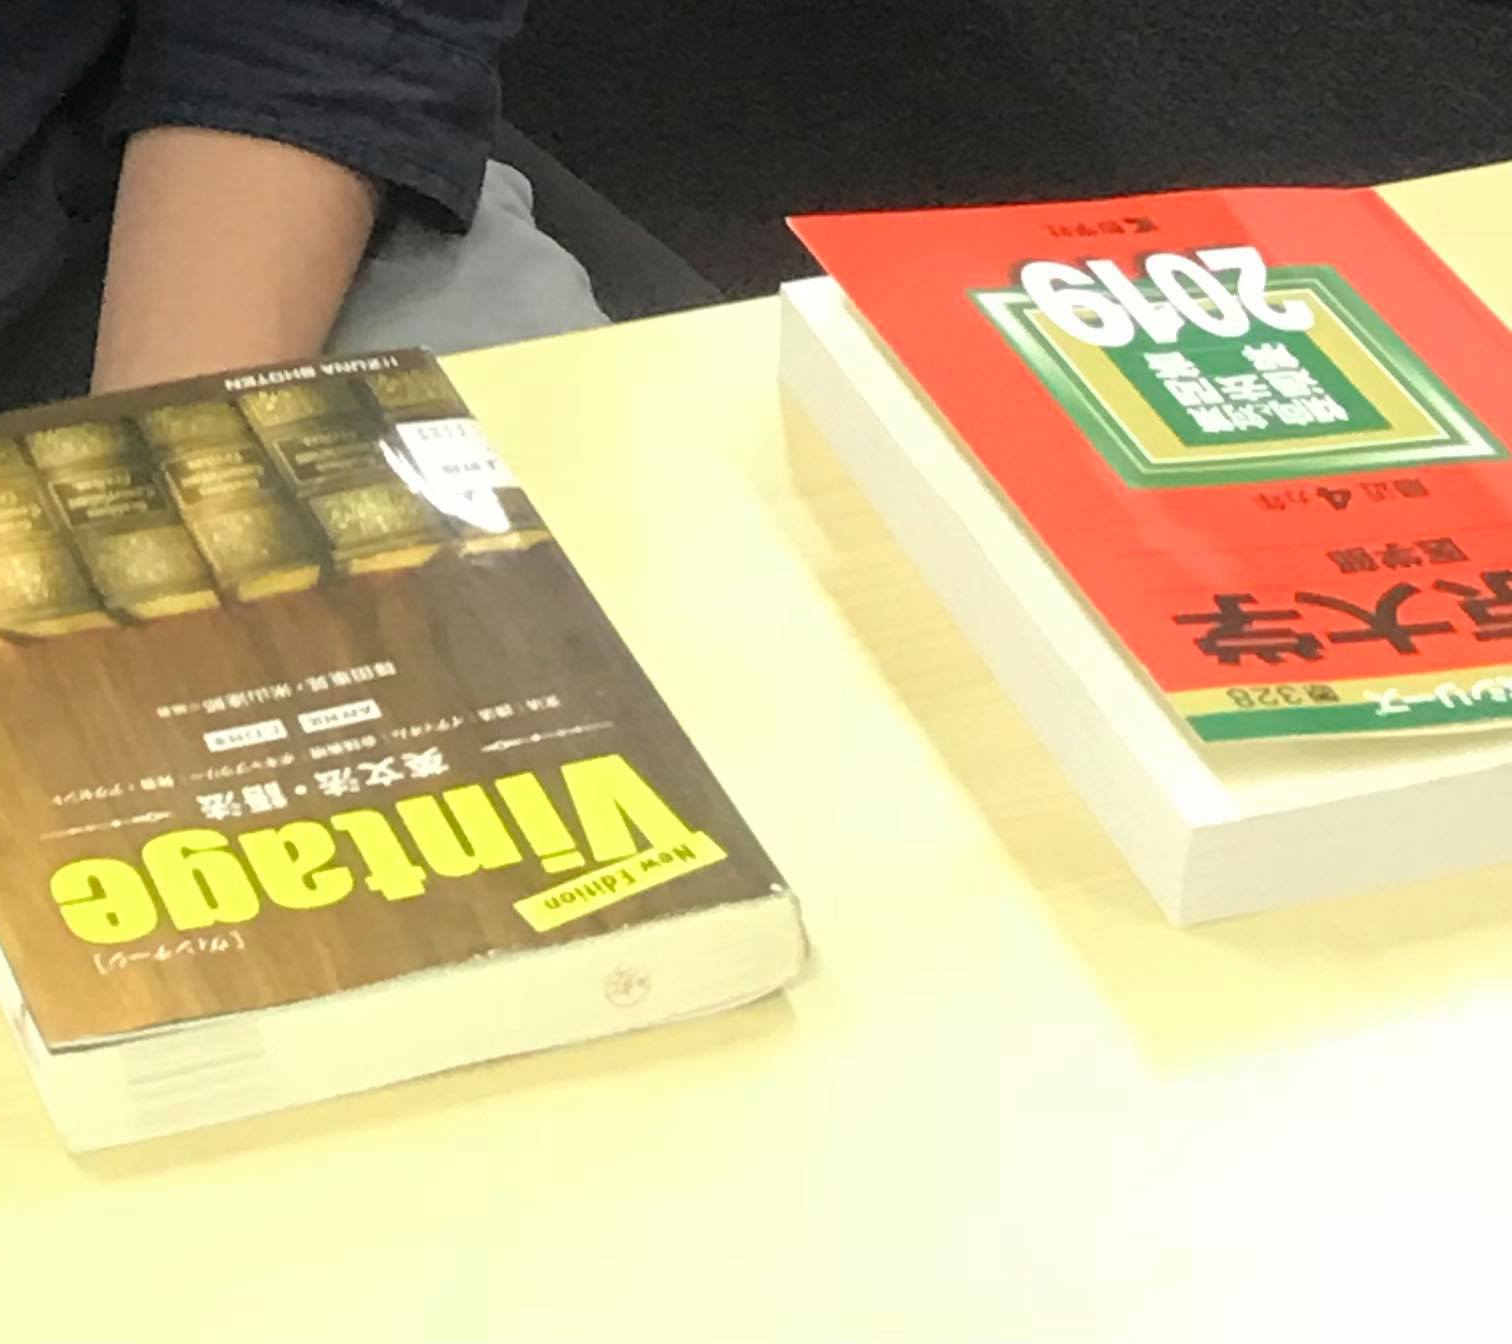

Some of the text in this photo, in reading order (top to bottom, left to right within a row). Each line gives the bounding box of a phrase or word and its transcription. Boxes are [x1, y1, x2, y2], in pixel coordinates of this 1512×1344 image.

[1021, 246, 1315, 348] 2019
[224, 366, 316, 392] SHOTEN
[1163, 368, 1322, 404] 過去問
[1186, 394, 1349, 434] 傾向と対策
[1327, 537, 1468, 574] 医学部
[1227, 686, 1302, 709] 328
[1364, 678, 1512, 716] シリーズ
[196, 746, 449, 820] 英文法・語法
[49, 753, 694, 945] Vintage
[543, 844, 694, 911] New Edition
